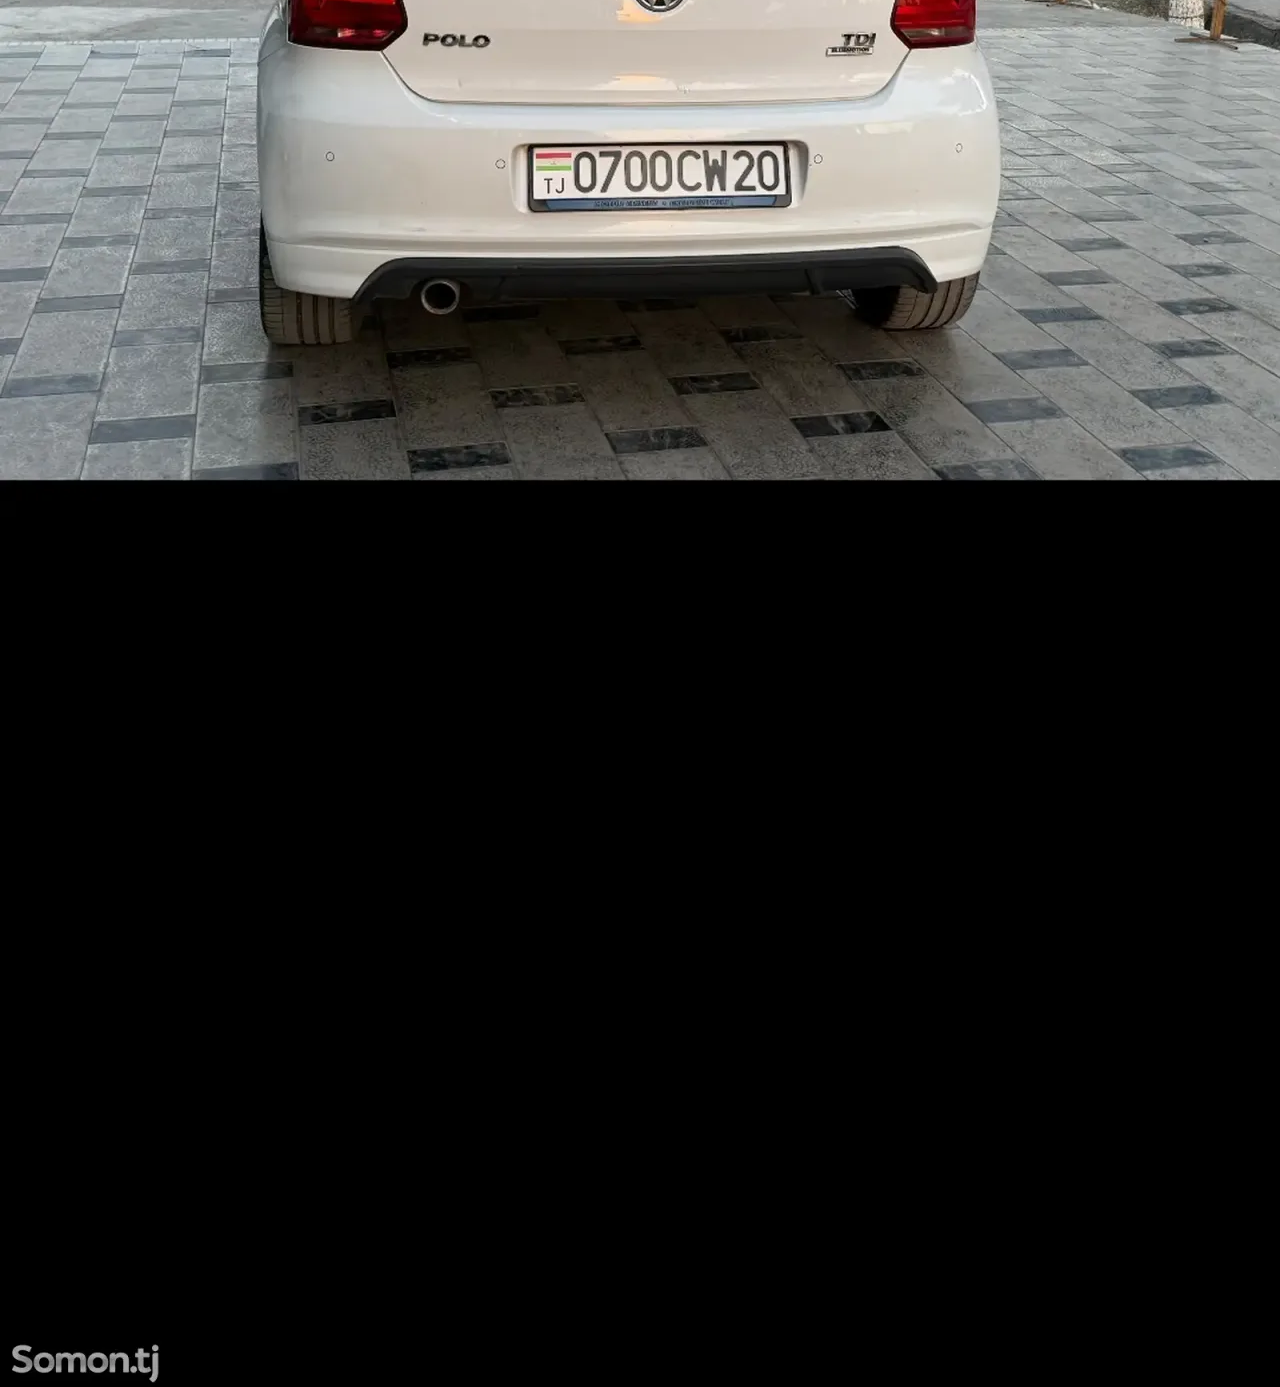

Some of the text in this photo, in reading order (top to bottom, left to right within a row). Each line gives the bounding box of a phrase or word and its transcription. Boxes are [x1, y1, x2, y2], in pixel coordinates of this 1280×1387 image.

[422, 32, 491, 49] POLO
[842, 32, 877, 47] TDI
[543, 178, 565, 195] TJ
